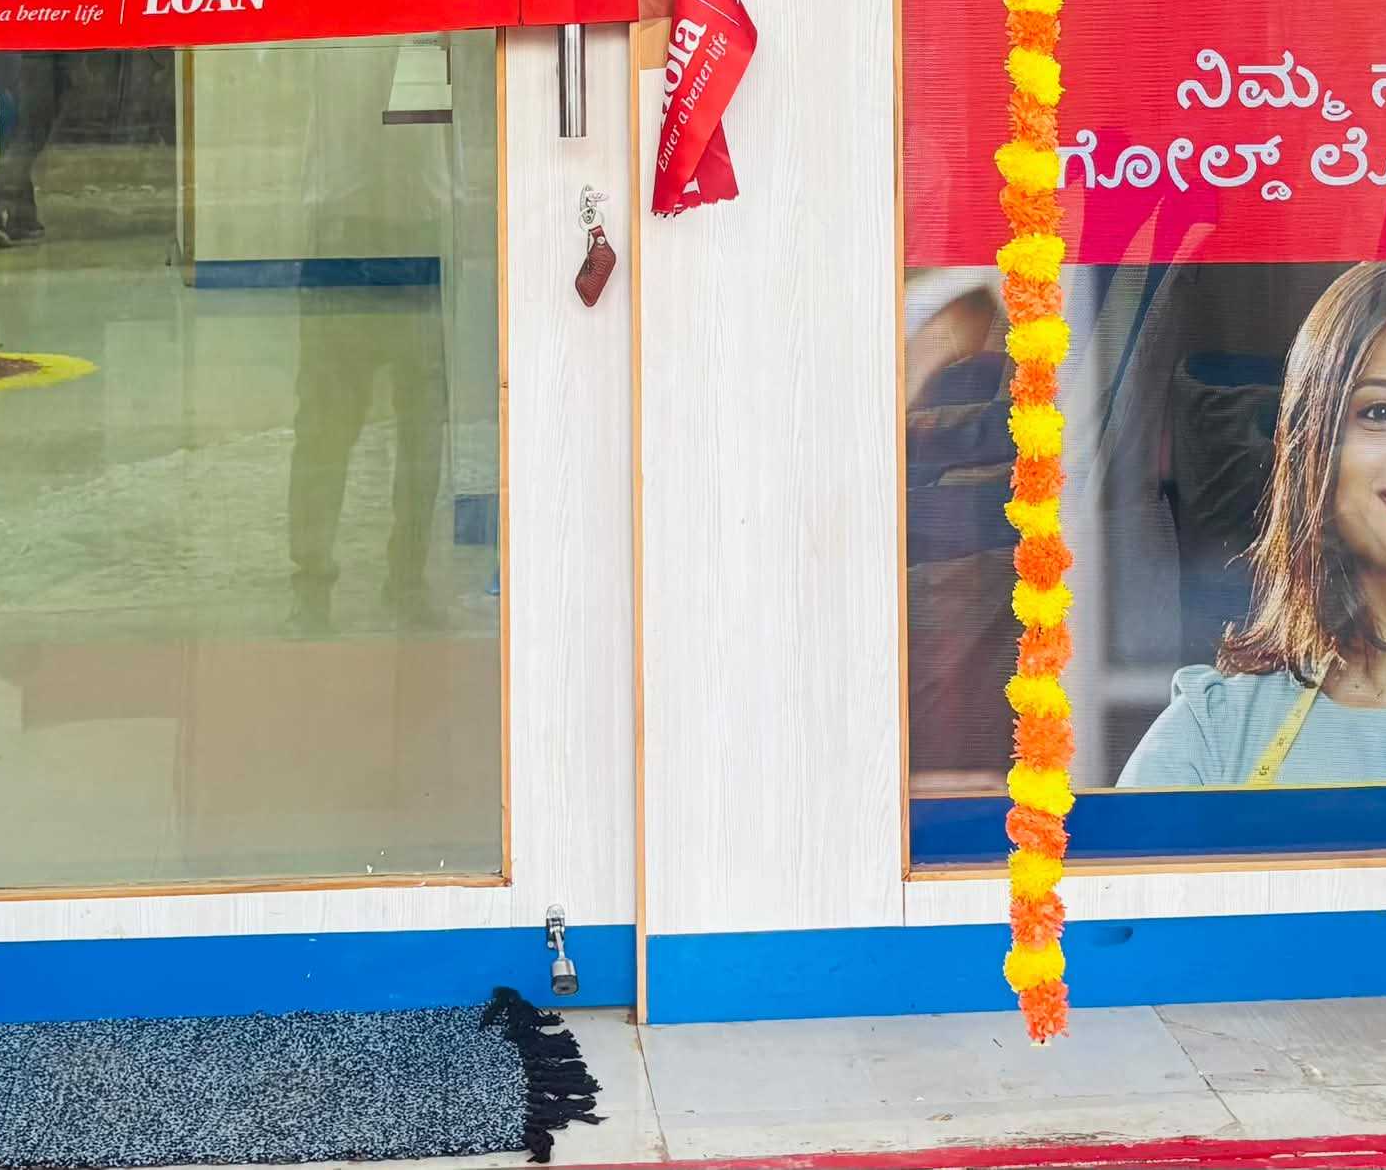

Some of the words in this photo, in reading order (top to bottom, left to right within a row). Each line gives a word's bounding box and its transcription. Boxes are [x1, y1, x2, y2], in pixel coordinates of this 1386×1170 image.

[15, 5, 70, 23] better
[74, 4, 105, 26] life
[658, 125, 680, 173] Enter
[677, 110, 689, 126] a
[684, 60, 713, 111] better
[707, 30, 729, 62] life
[1176, 47, 1353, 122] ನಿಮ್ಮ
[1057, 129, 1292, 201] ಗೋಲ್ಡ್
